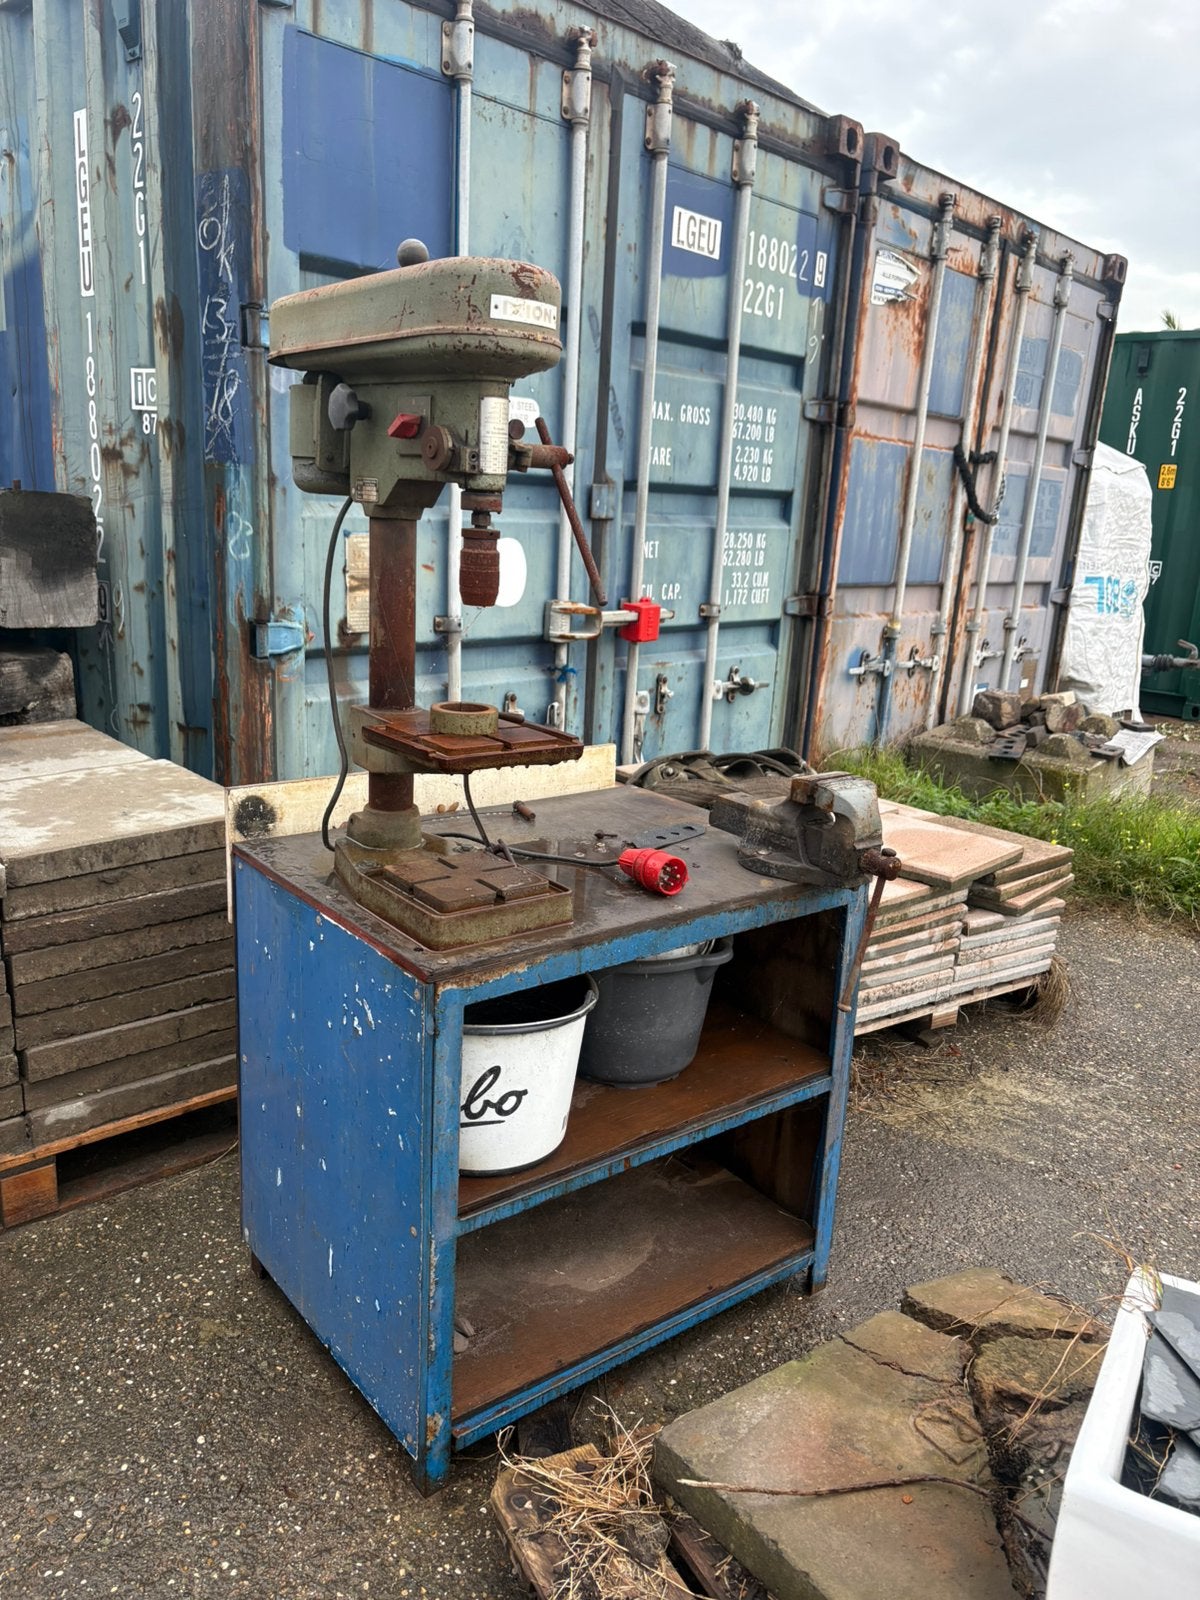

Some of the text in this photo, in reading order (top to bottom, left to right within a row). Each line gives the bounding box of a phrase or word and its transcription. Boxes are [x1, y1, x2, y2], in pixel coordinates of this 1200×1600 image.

[132, 91, 146, 285] 22G1
[76, 117, 92, 292] LGEU
[676, 211, 718, 256] LGEU
[749, 230, 809, 282] 188022
[816, 254, 826, 285] 9
[742, 279, 785, 321] 22G1
[142, 413, 158, 434] 87
[680, 403, 711, 426] GROSS
[733, 402, 763, 423] 30.480
[765, 407, 777, 425] KG
[1126, 387, 1143, 456] ASKU
[1170, 386, 1188, 457] 22G1
[732, 421, 776, 443] 67.200 LB
[734, 444, 760, 464] 2.230
[762, 448, 773, 465] KG
[733, 463, 772, 483] 4.920 LB
[643, 532, 767, 559] NET 28.250 KG
[754, 549, 765, 567] LB
[731, 571, 750, 588] 33.2
[661, 582, 682, 601] CAP.
[725, 589, 748, 605] 1.172
[460, 1065, 529, 1121] bo
